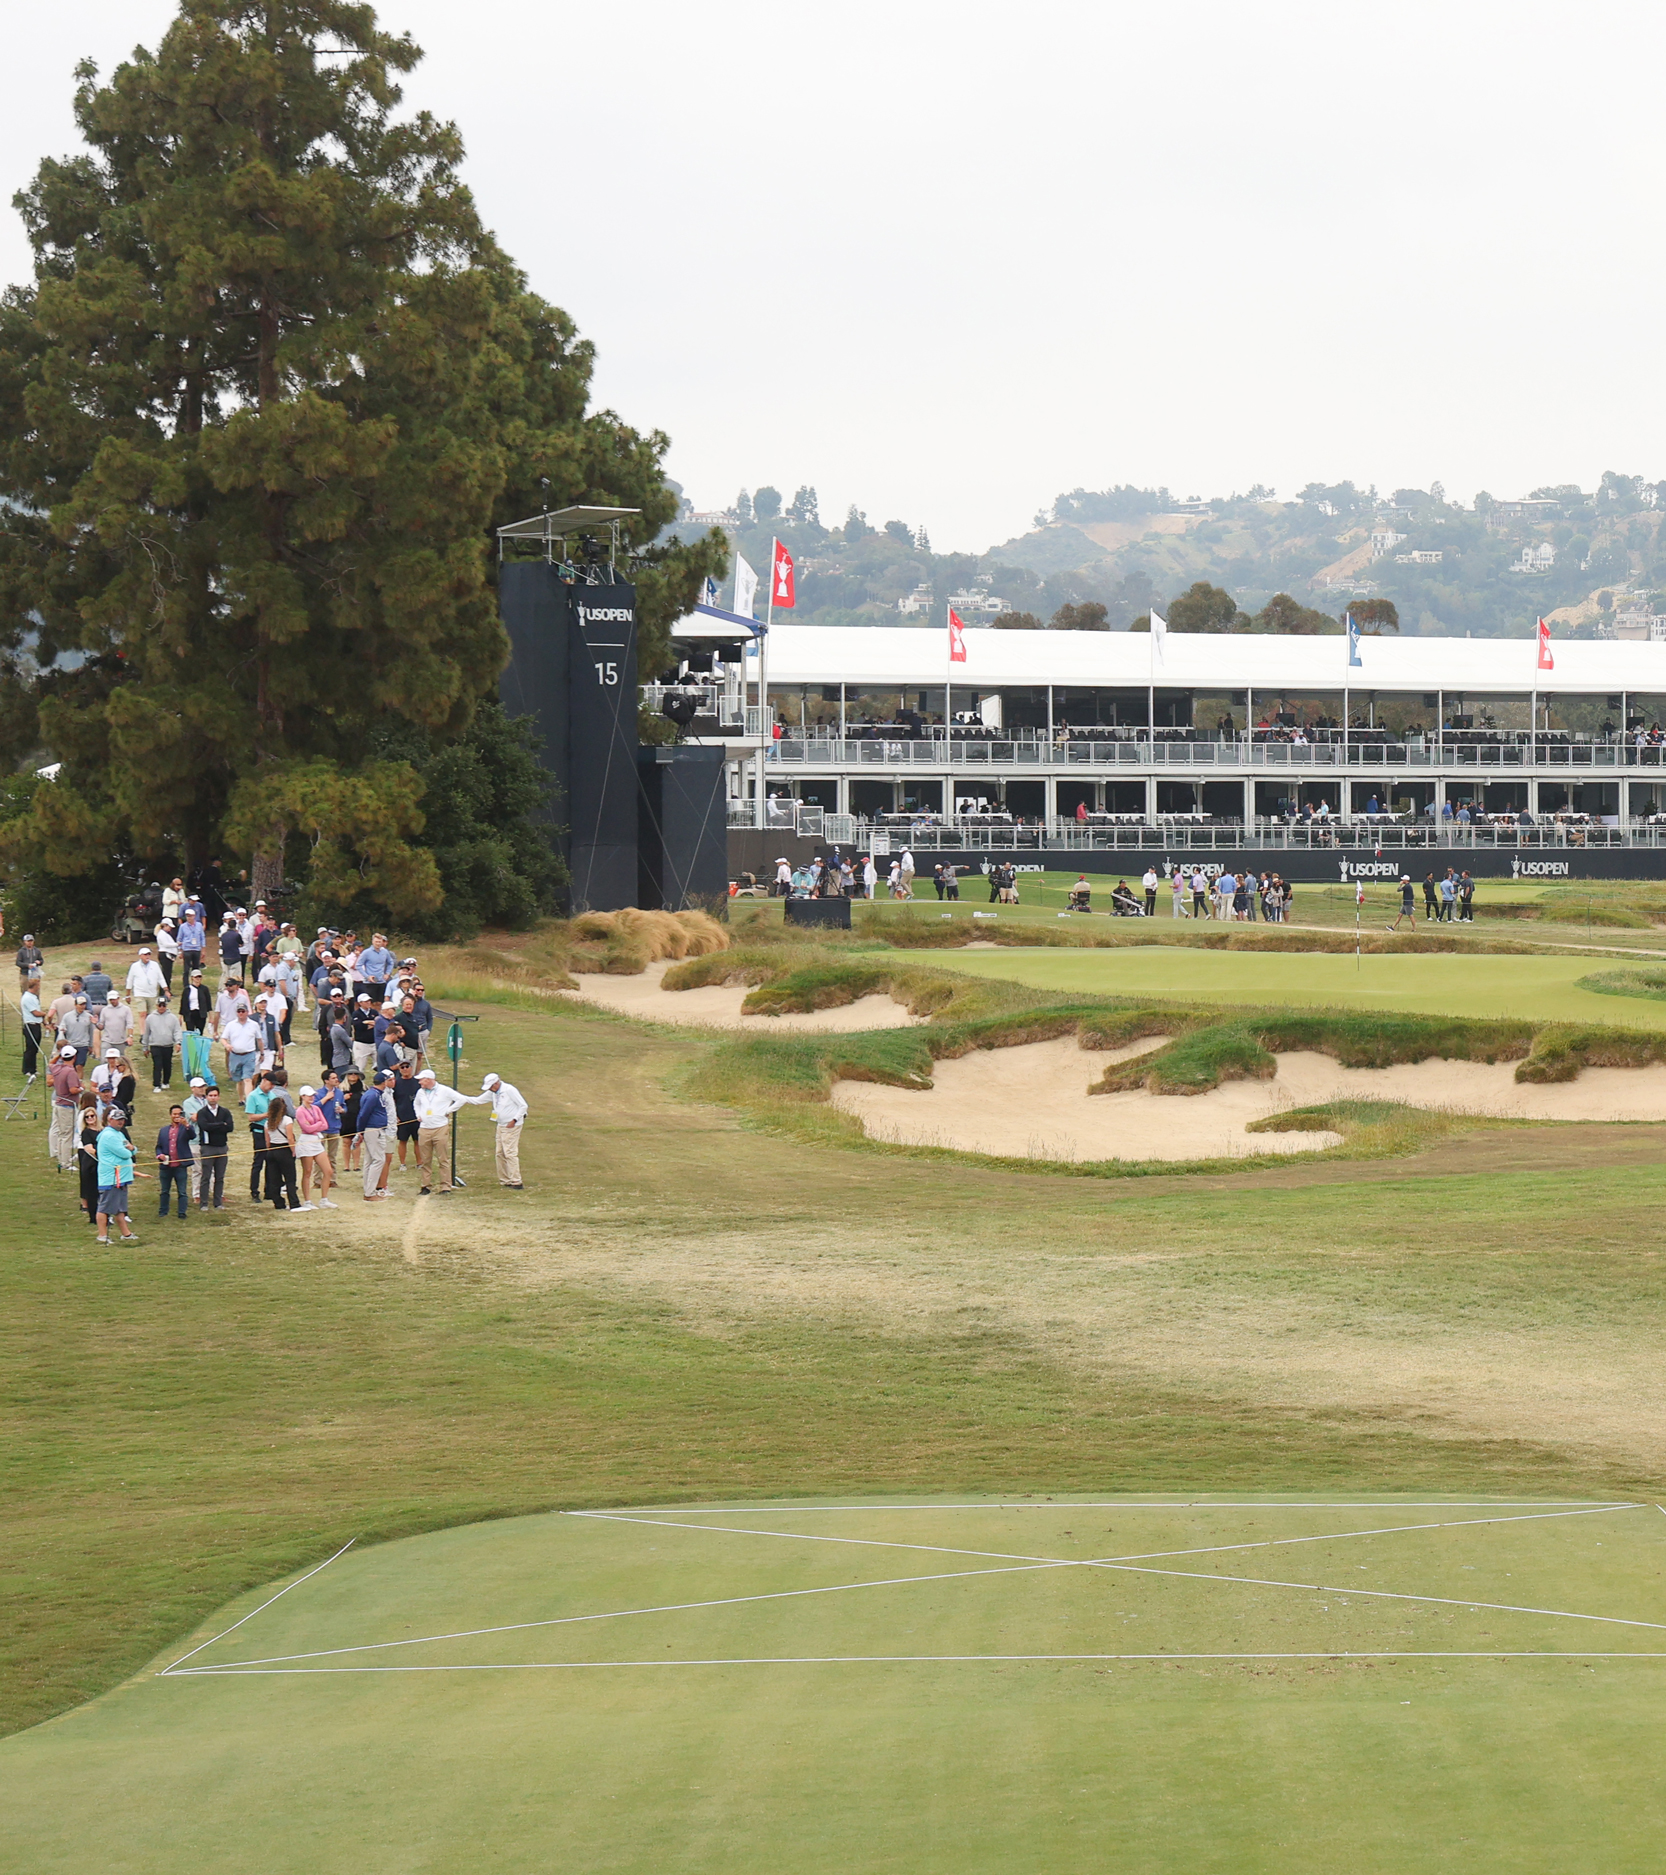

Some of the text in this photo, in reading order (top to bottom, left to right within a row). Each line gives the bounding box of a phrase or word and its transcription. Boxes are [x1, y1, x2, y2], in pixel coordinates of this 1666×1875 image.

[586, 608, 632, 621] USOPEN
[595, 662, 618, 685] 15
[1349, 862, 1399, 876] USOPEN
[1521, 861, 1569, 875] USOPEN
